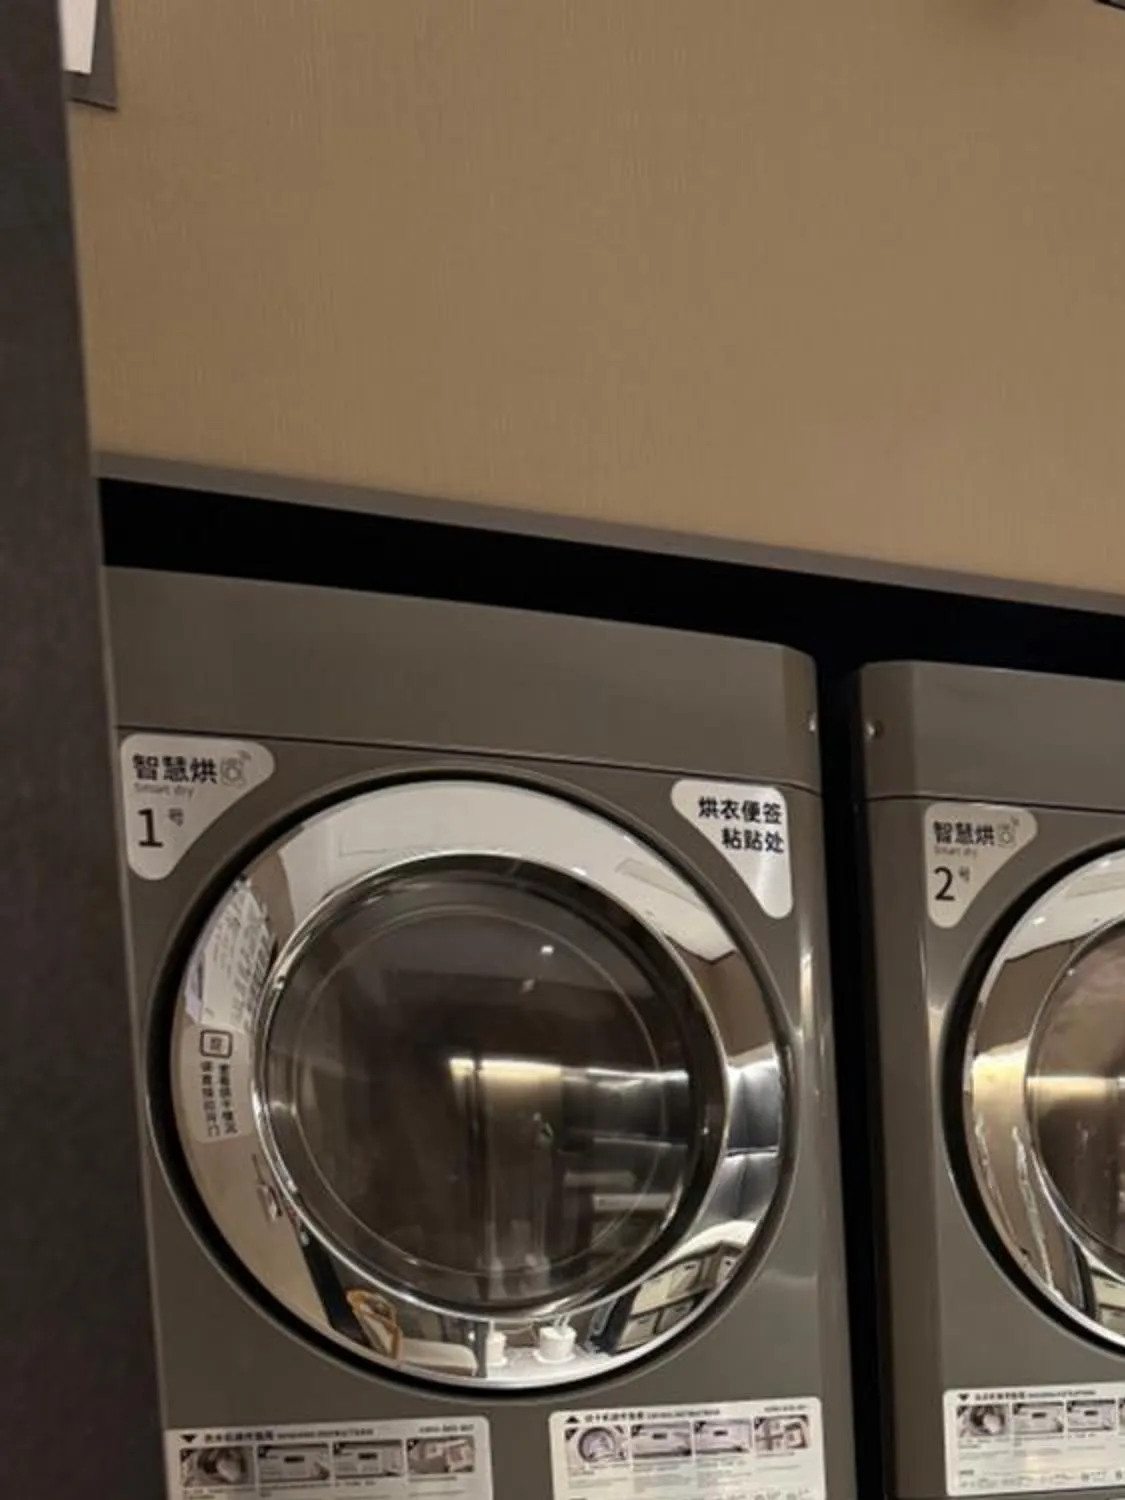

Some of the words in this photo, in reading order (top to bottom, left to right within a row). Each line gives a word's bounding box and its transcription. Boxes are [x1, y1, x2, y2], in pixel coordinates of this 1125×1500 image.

[132, 753, 218, 784] 智慧烘
[698, 796, 782, 824] 烘衣便签
[722, 827, 784, 853] 粘贴处
[933, 821, 995, 846] 智慧烘
